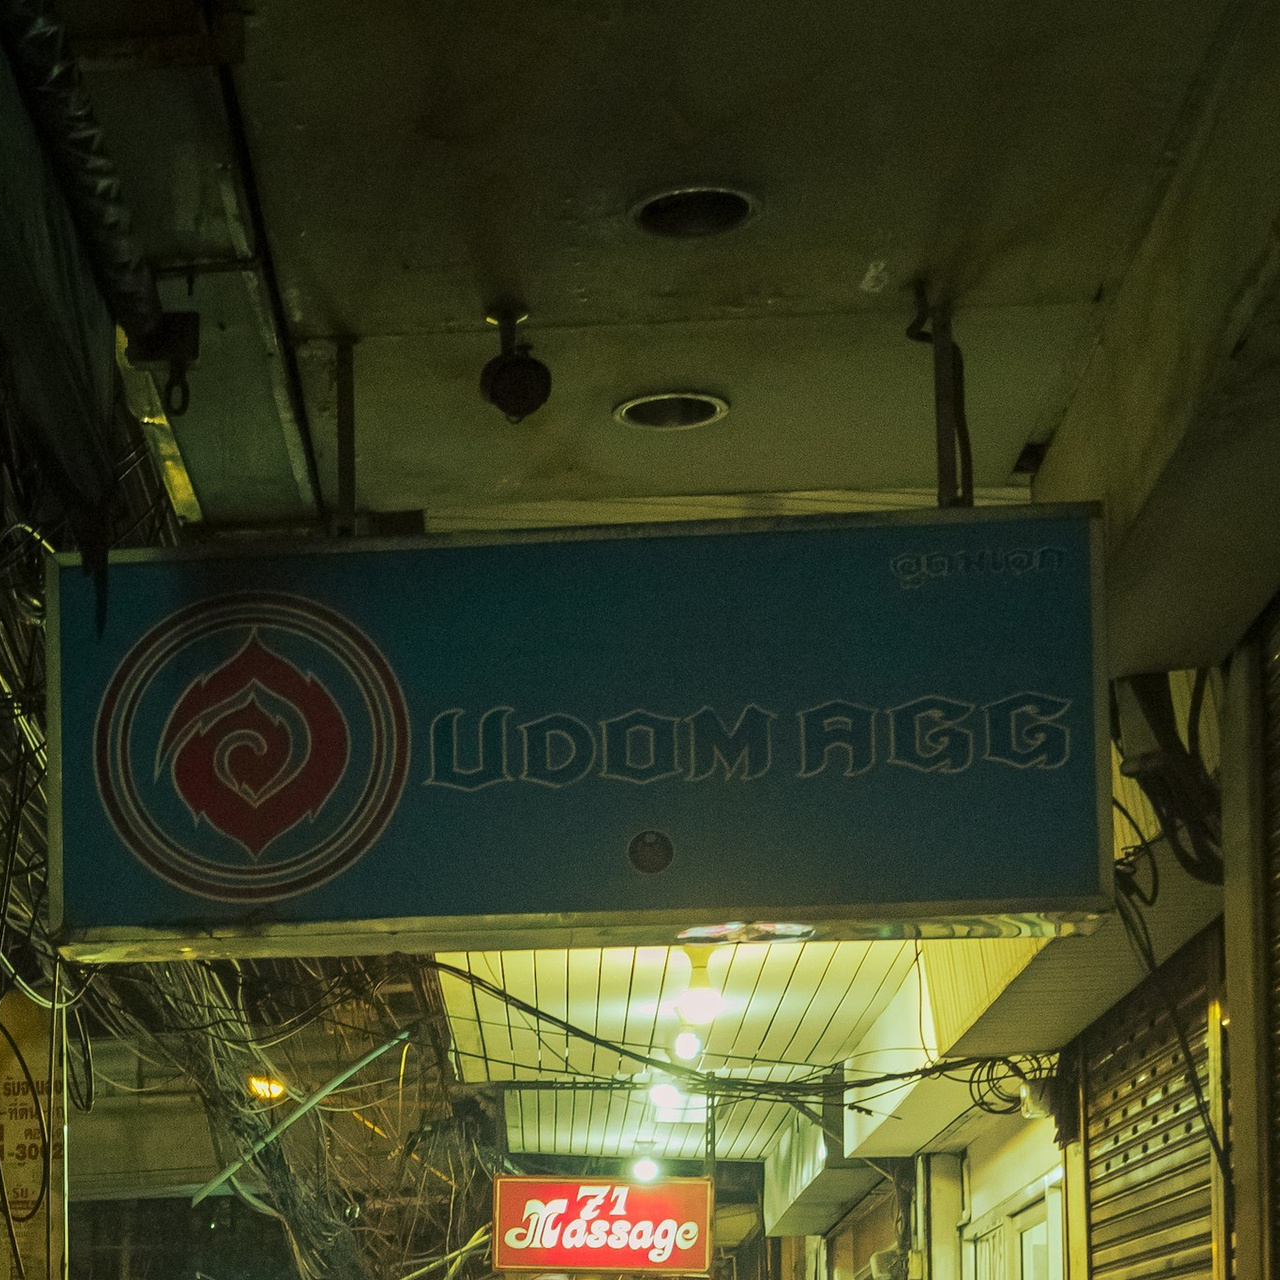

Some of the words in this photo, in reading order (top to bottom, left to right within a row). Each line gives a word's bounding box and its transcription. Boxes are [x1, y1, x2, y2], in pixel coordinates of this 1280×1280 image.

[425, 703, 780, 791] UDOM
[798, 693, 1071, 776] AGG
[504, 1199, 698, 1262] Massage
[577, 1186, 629, 1220] 71
